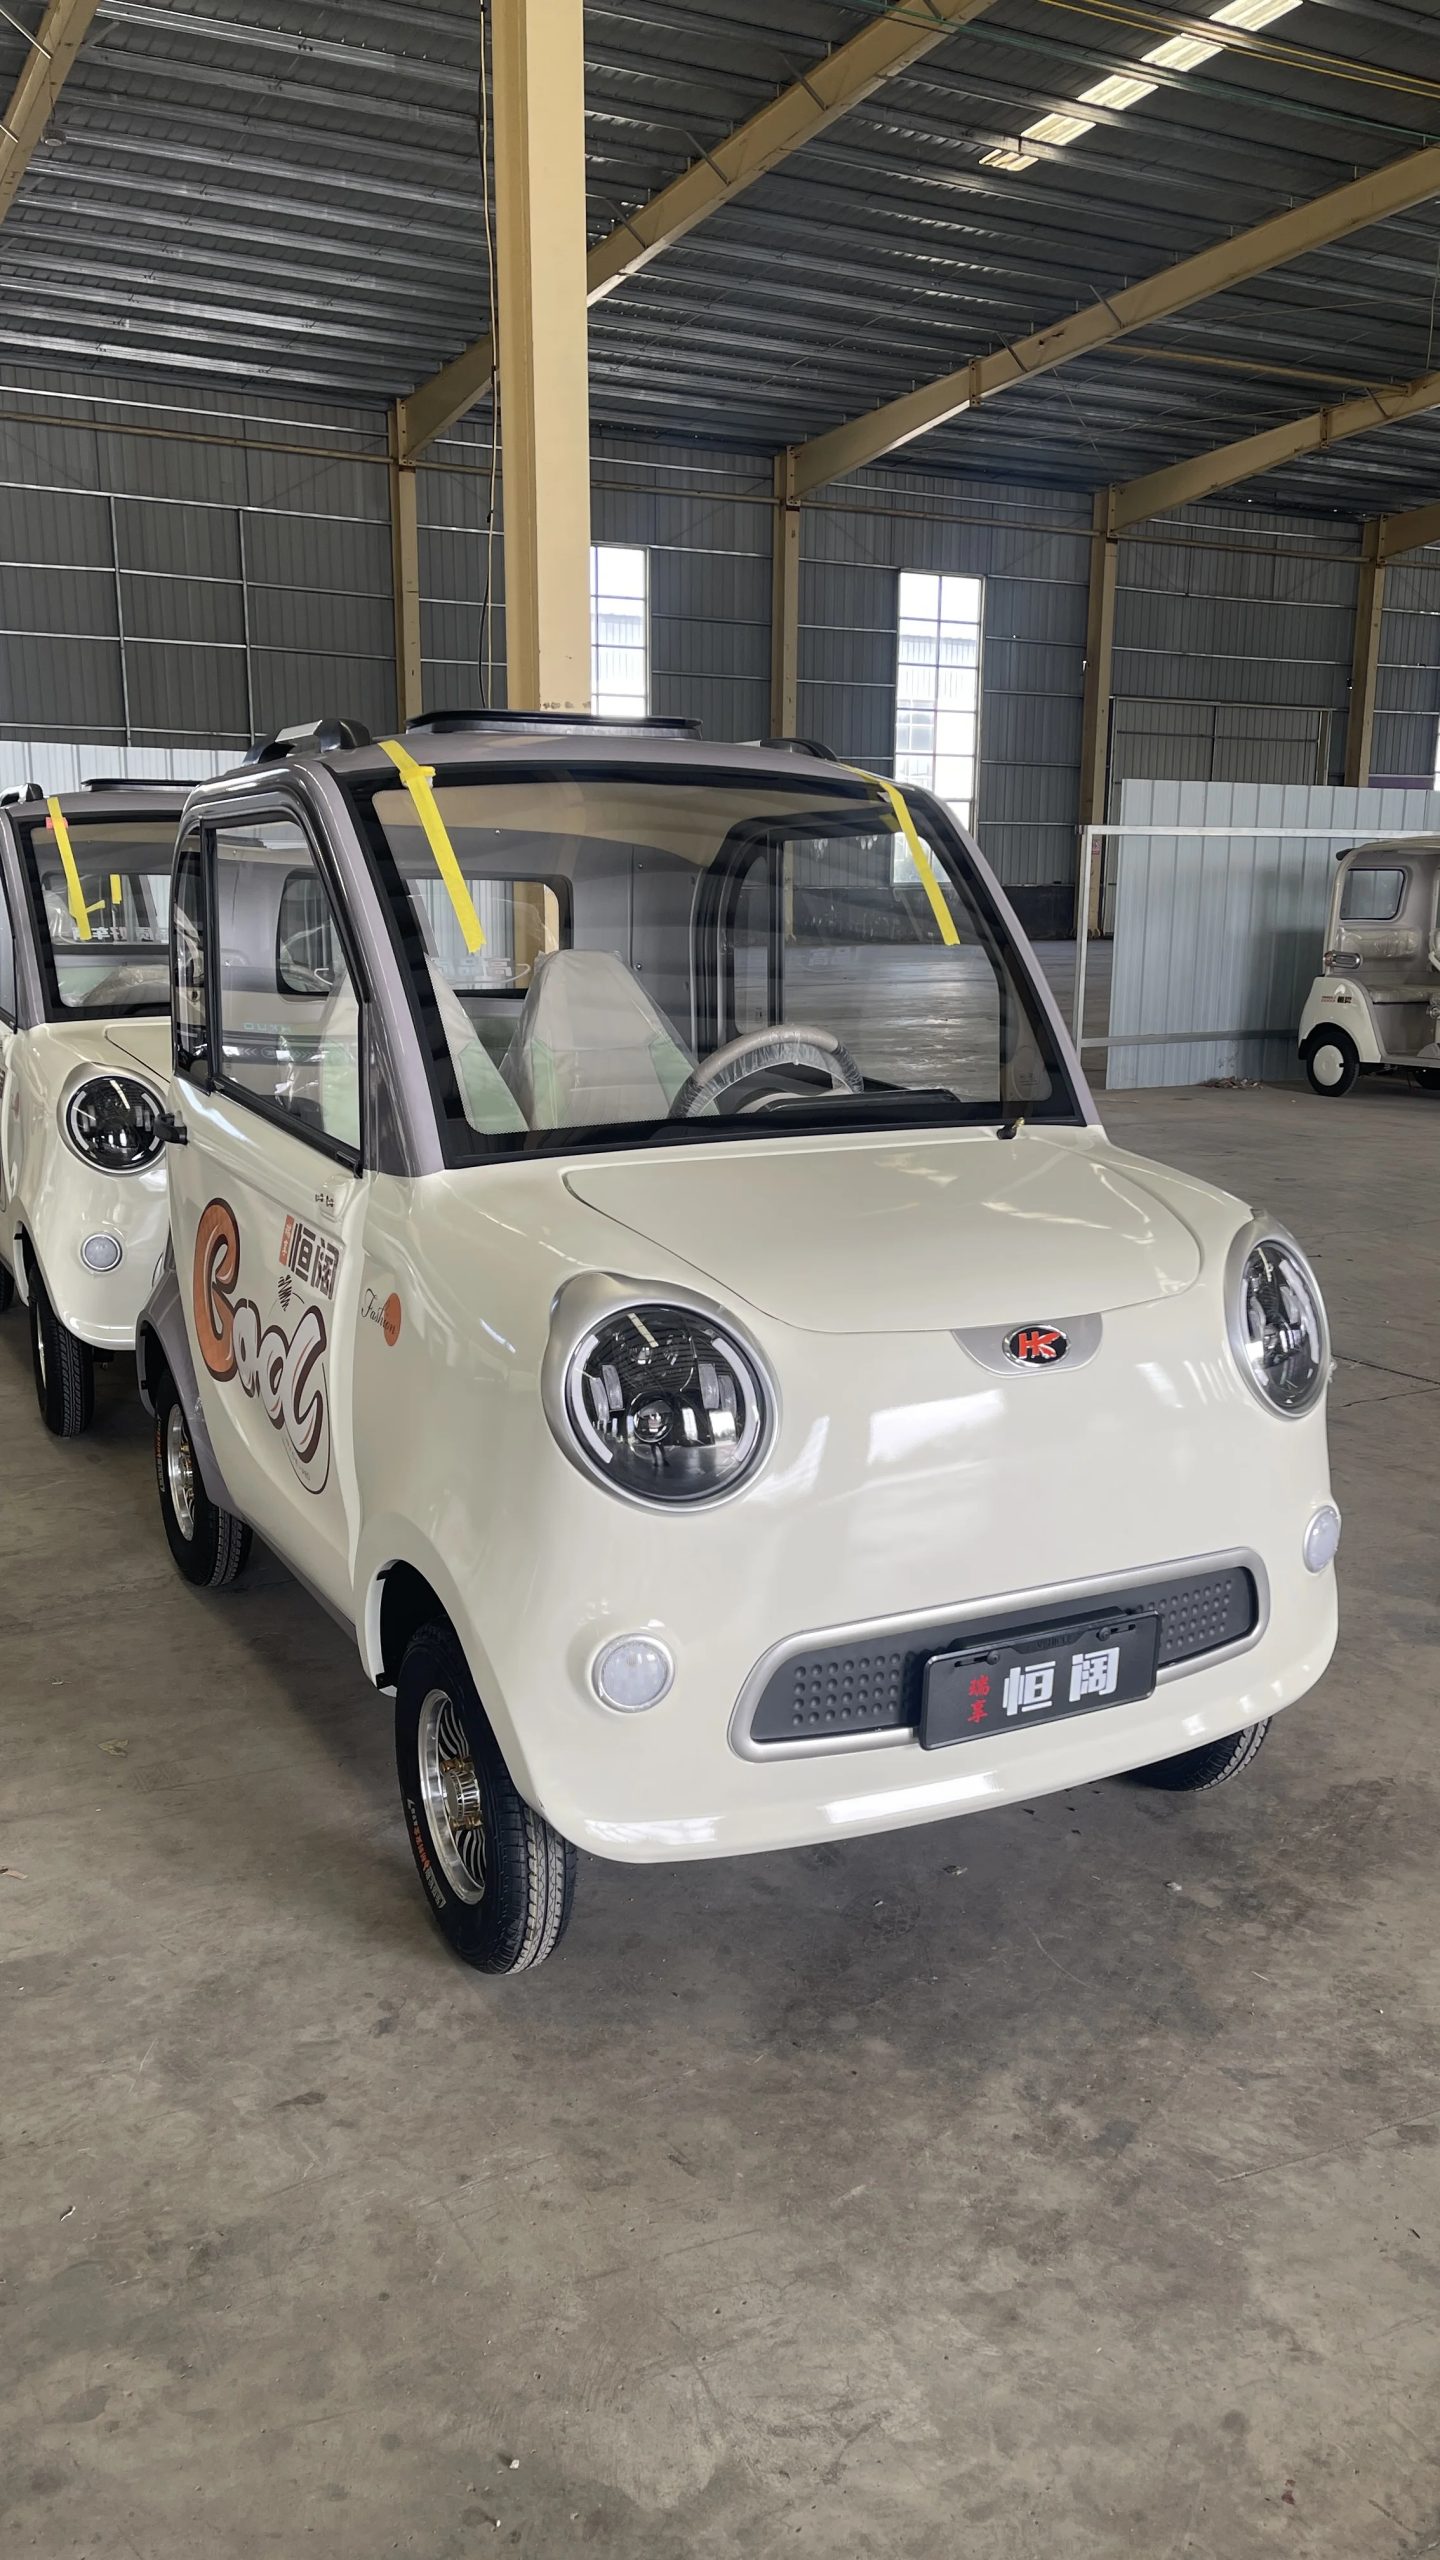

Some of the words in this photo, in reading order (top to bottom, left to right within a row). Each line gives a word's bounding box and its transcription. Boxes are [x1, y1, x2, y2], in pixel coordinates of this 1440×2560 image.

[361, 1288, 397, 1335] Fashion
[1018, 1330, 1061, 1359] HK
[1002, 1647, 1120, 1716] 恒阔
